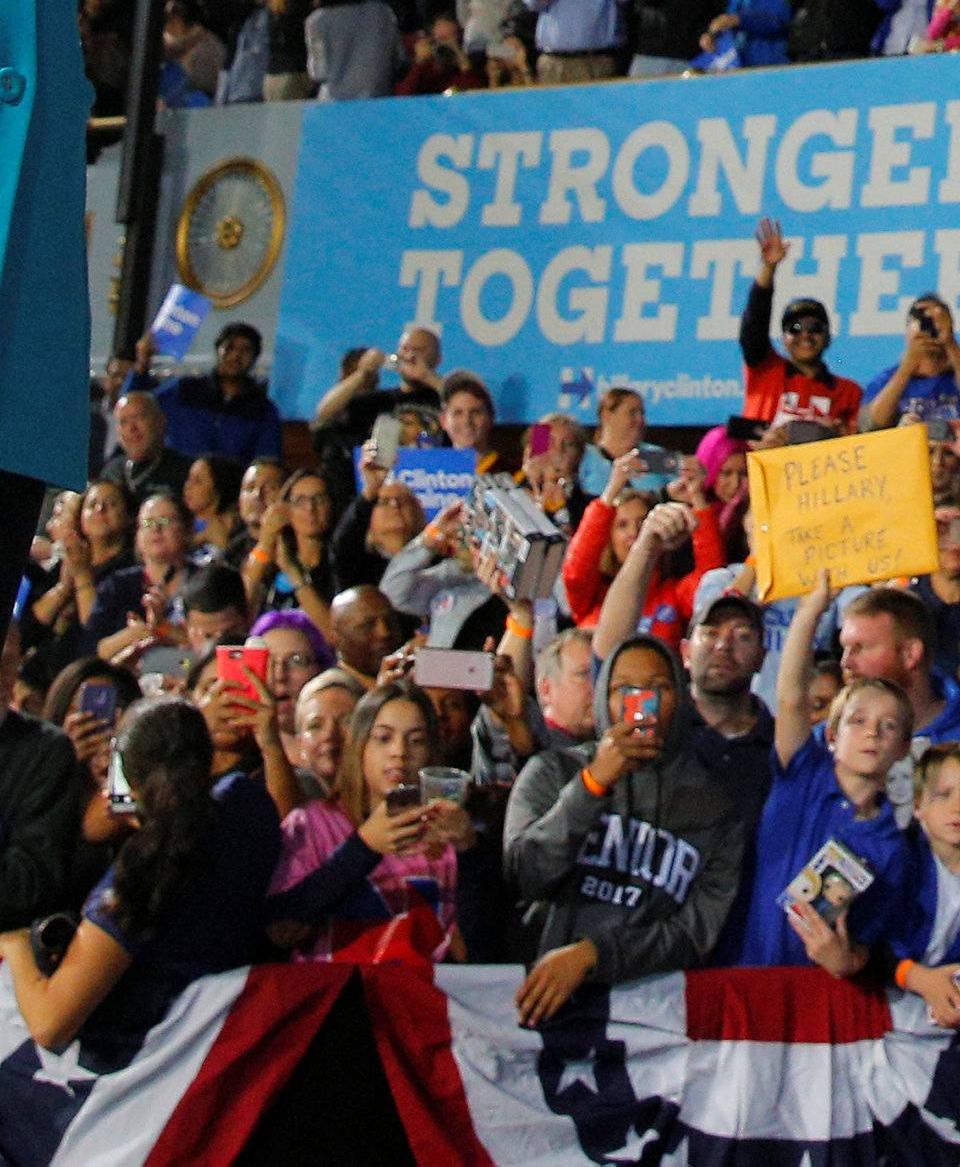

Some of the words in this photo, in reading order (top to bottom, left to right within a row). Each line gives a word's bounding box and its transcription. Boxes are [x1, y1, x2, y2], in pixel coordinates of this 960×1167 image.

[408, 100, 960, 229] STRONGE
[398, 467, 473, 492] Clinton
[784, 445, 867, 491] PLEASE
[804, 528, 887, 565] PICTURE
[577, 814, 701, 904] ENIOR
[581, 876, 642, 907] 2017
